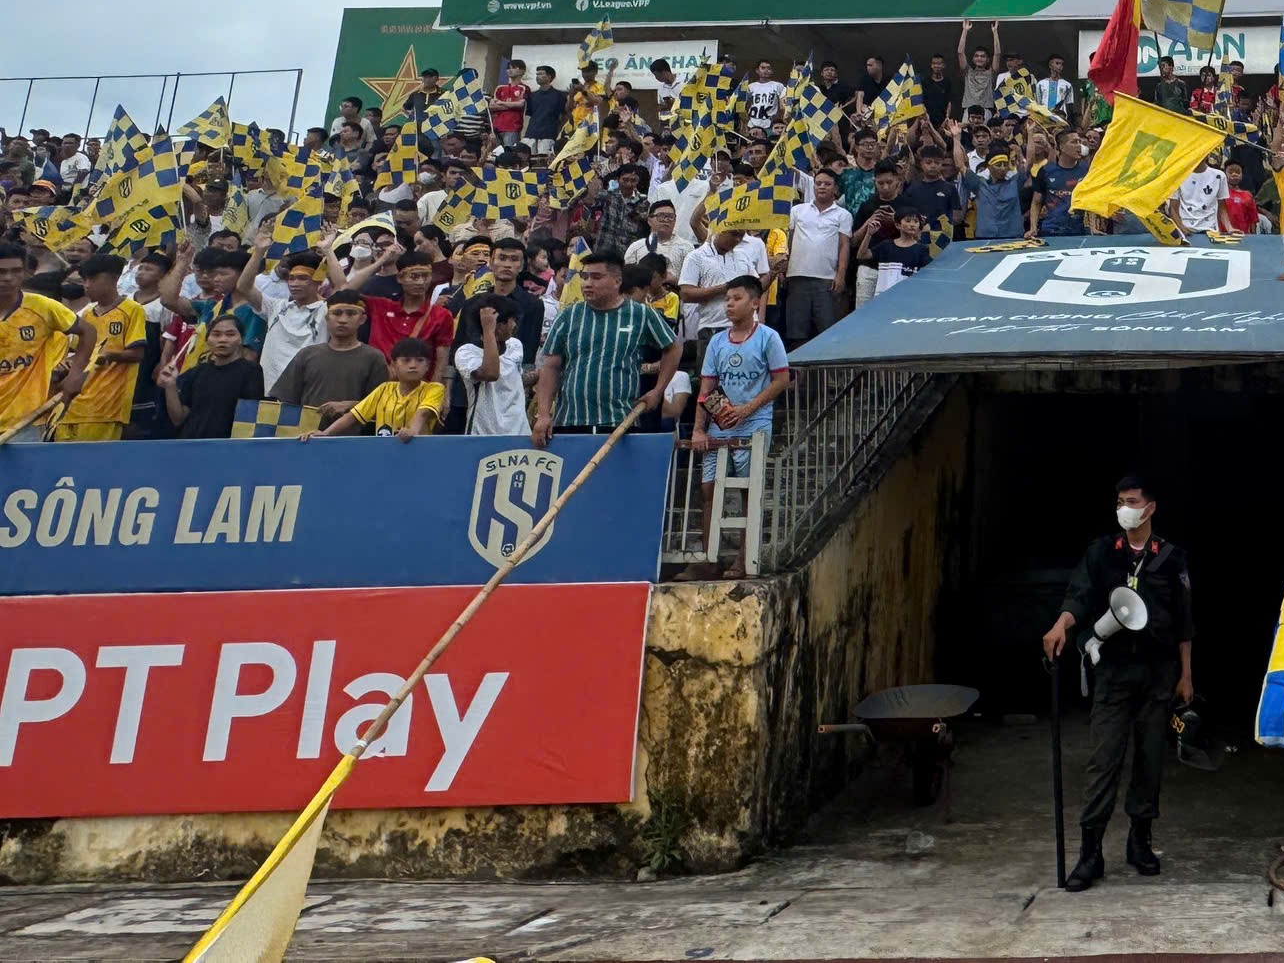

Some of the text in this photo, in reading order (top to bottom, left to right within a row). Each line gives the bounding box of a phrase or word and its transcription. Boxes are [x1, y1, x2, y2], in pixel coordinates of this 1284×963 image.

[624, 53, 653, 70] ĂN
[1026, 246, 1149, 261] SLNA
[485, 455, 557, 472] SLNA FC
[0, 477, 302, 548] SÔNG LAM
[202, 639, 510, 792] Play
